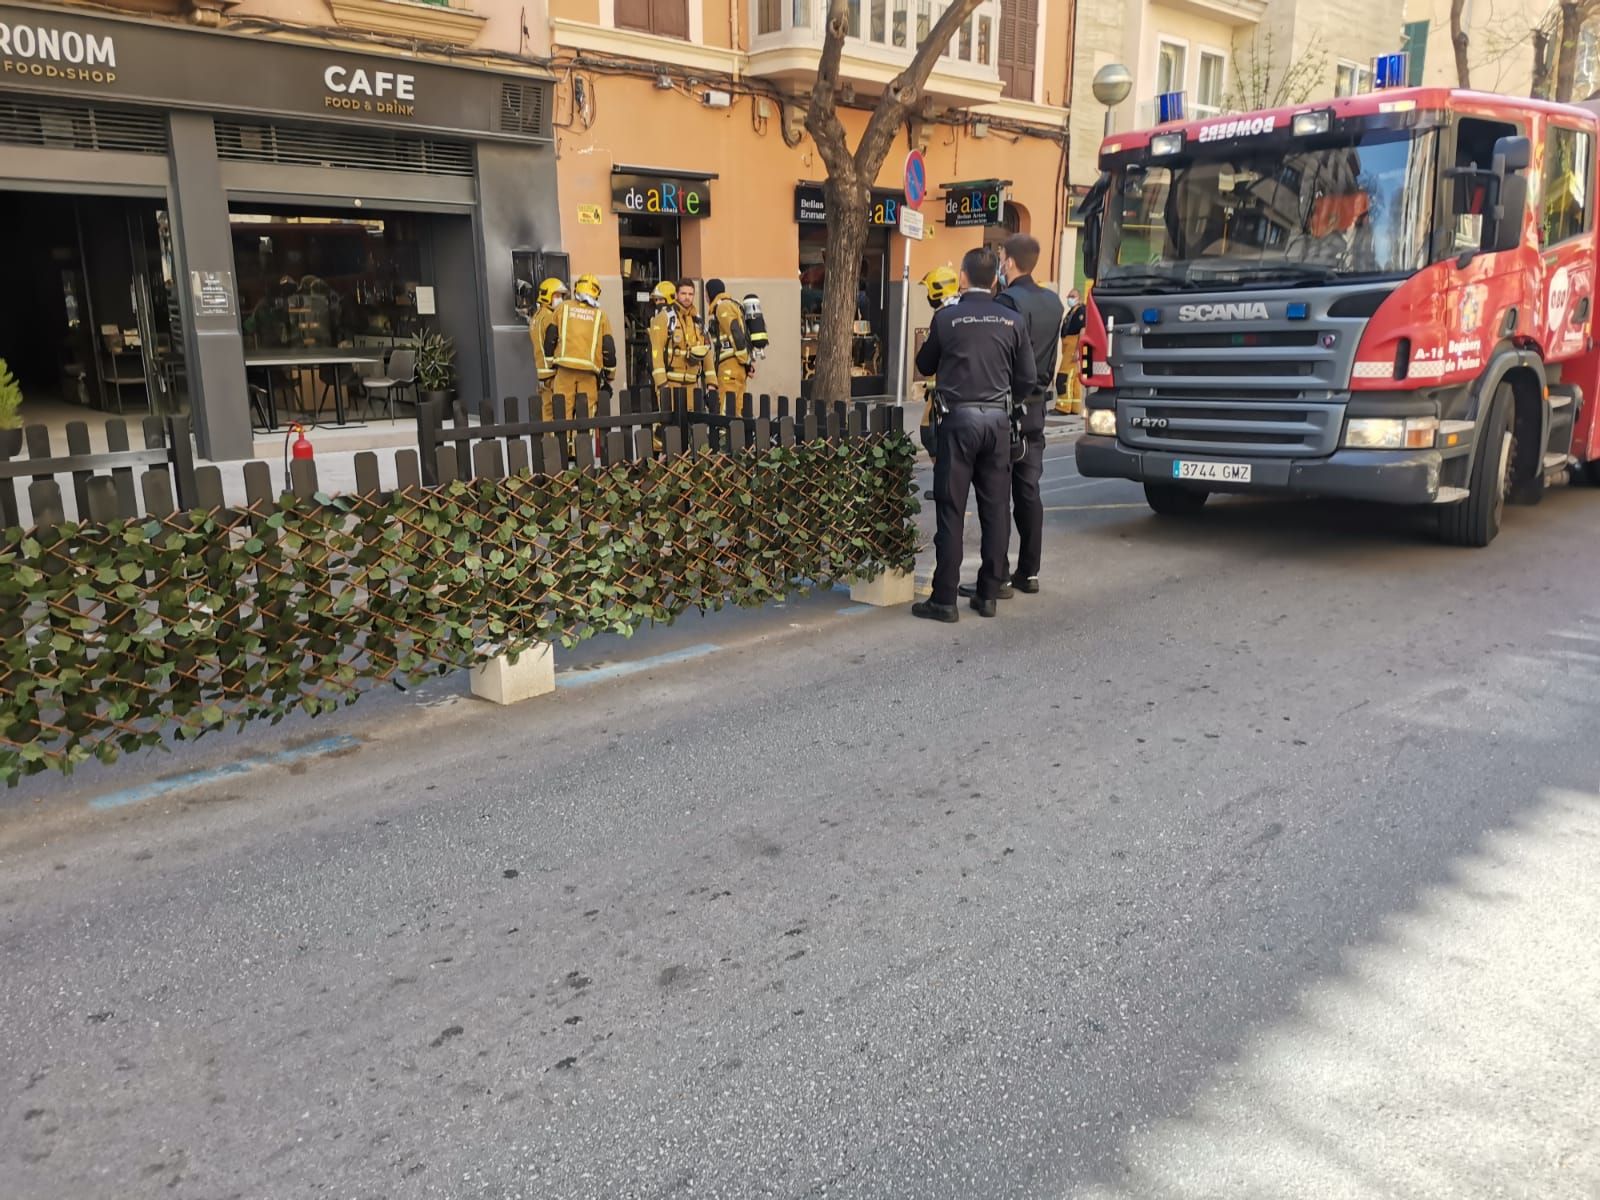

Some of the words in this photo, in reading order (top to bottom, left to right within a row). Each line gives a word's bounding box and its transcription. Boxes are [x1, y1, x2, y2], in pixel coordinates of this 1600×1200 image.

[324, 65, 415, 100] CAFE
[325, 96, 360, 110] FOOD
[364, 100, 372, 112] &
[625, 187, 643, 210] de
[646, 182, 700, 214] aRte
[800, 199, 824, 209] Bellas
[945, 198, 958, 214] de
[1178, 302, 1269, 322] SCANIA
[1131, 417, 1141, 428] P
[1142, 418, 1168, 428] 270
[1182, 463, 1216, 478] 3744
[1222, 464, 1250, 480] GMZ
